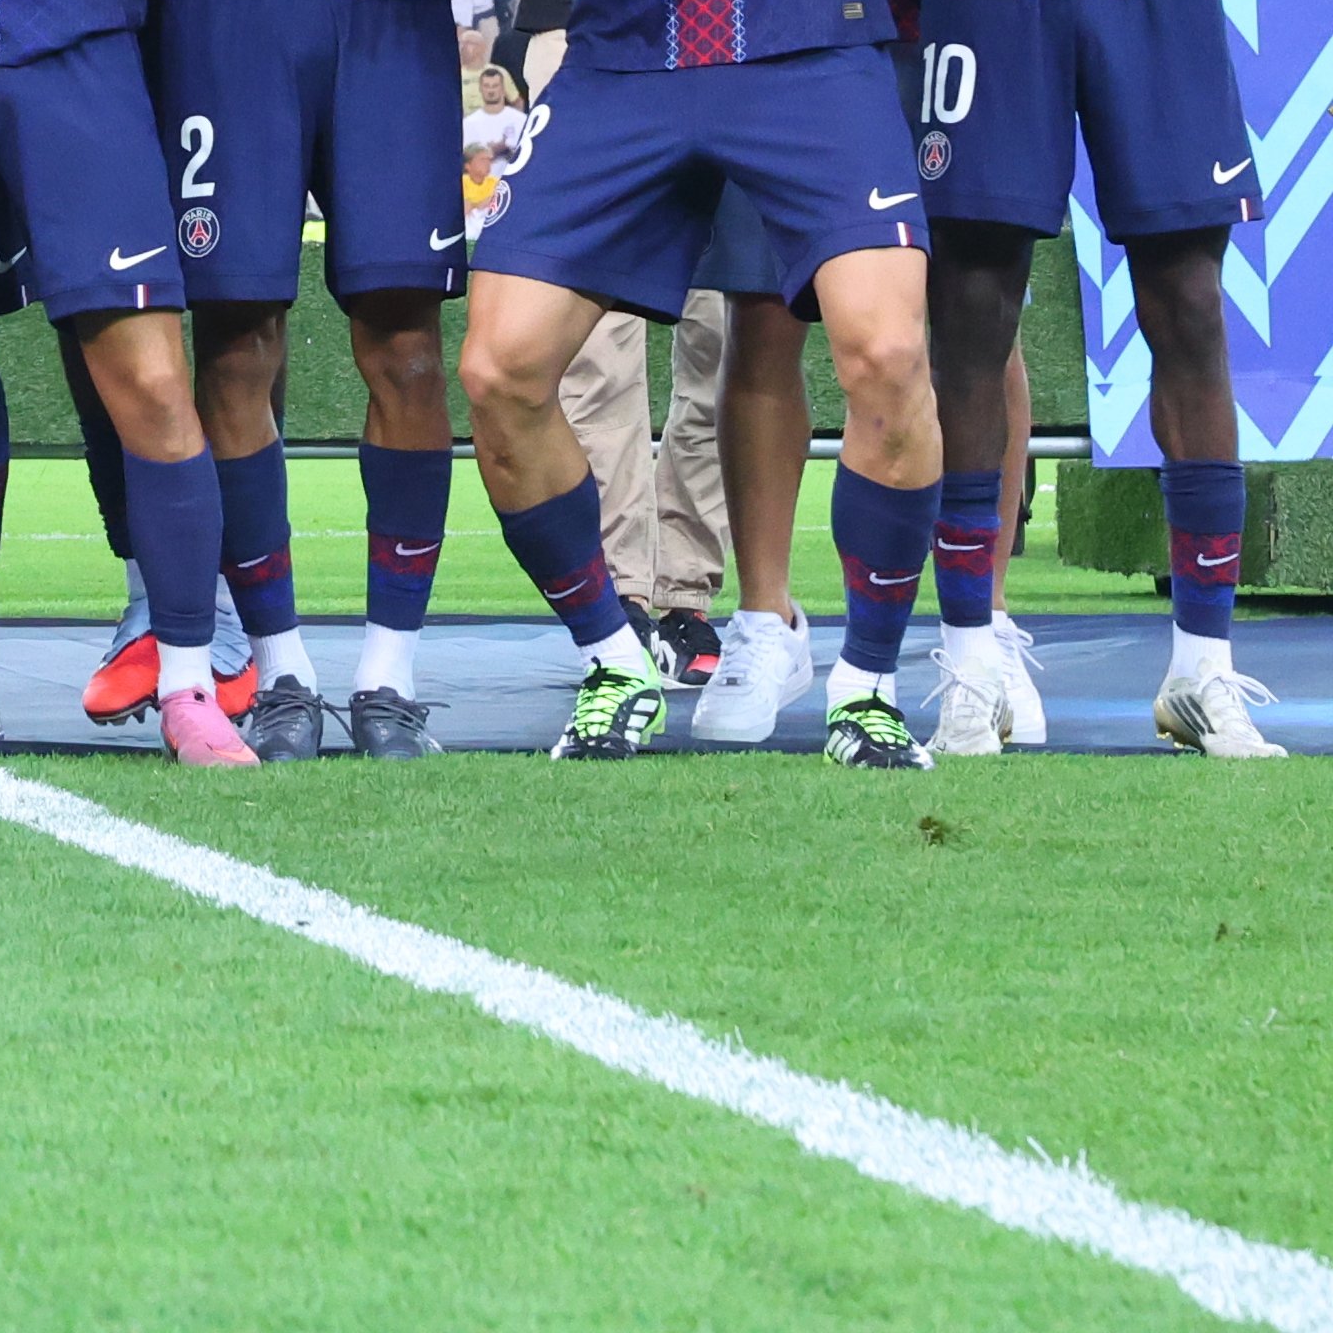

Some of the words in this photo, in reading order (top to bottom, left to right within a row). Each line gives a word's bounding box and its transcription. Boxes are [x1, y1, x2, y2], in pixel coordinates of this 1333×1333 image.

[919, 41, 978, 125] 10
[180, 115, 216, 199] 2
[183, 208, 213, 223] PARIS
